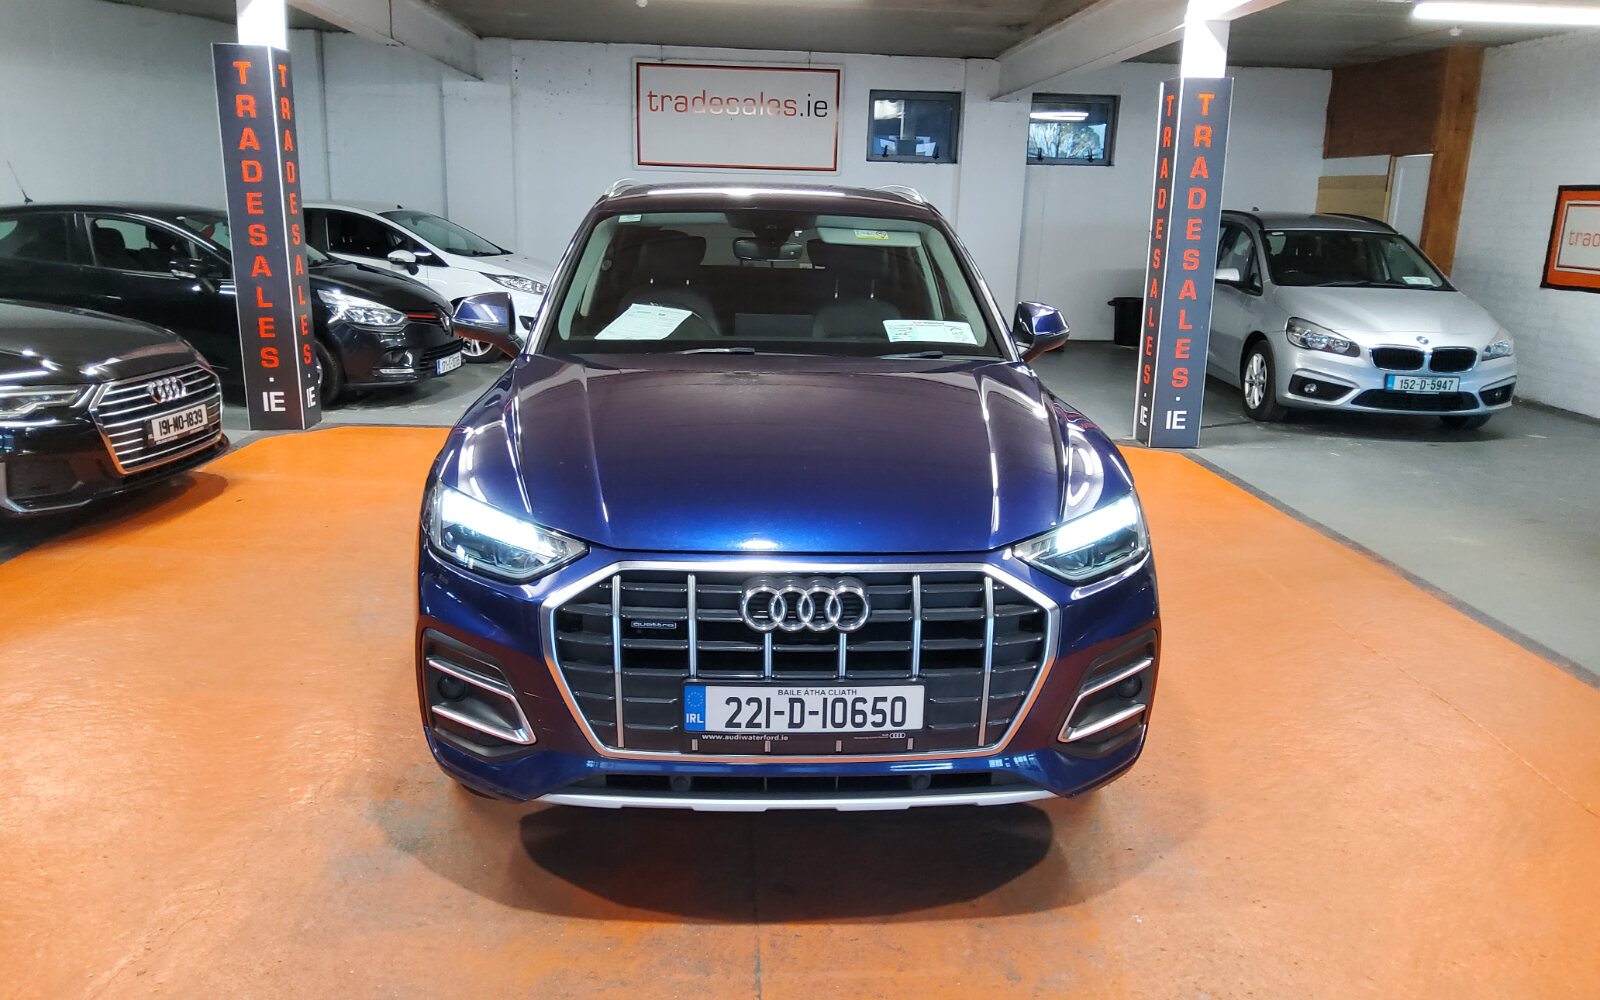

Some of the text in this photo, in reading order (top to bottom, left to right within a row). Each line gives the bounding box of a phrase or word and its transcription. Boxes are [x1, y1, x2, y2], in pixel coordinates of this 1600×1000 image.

[648, 90, 828, 118] tradesales.ie
[1400, 379, 1454, 391] 152-D-5947
[686, 713, 704, 723] IRL
[725, 696, 907, 729] 221-D-10650
